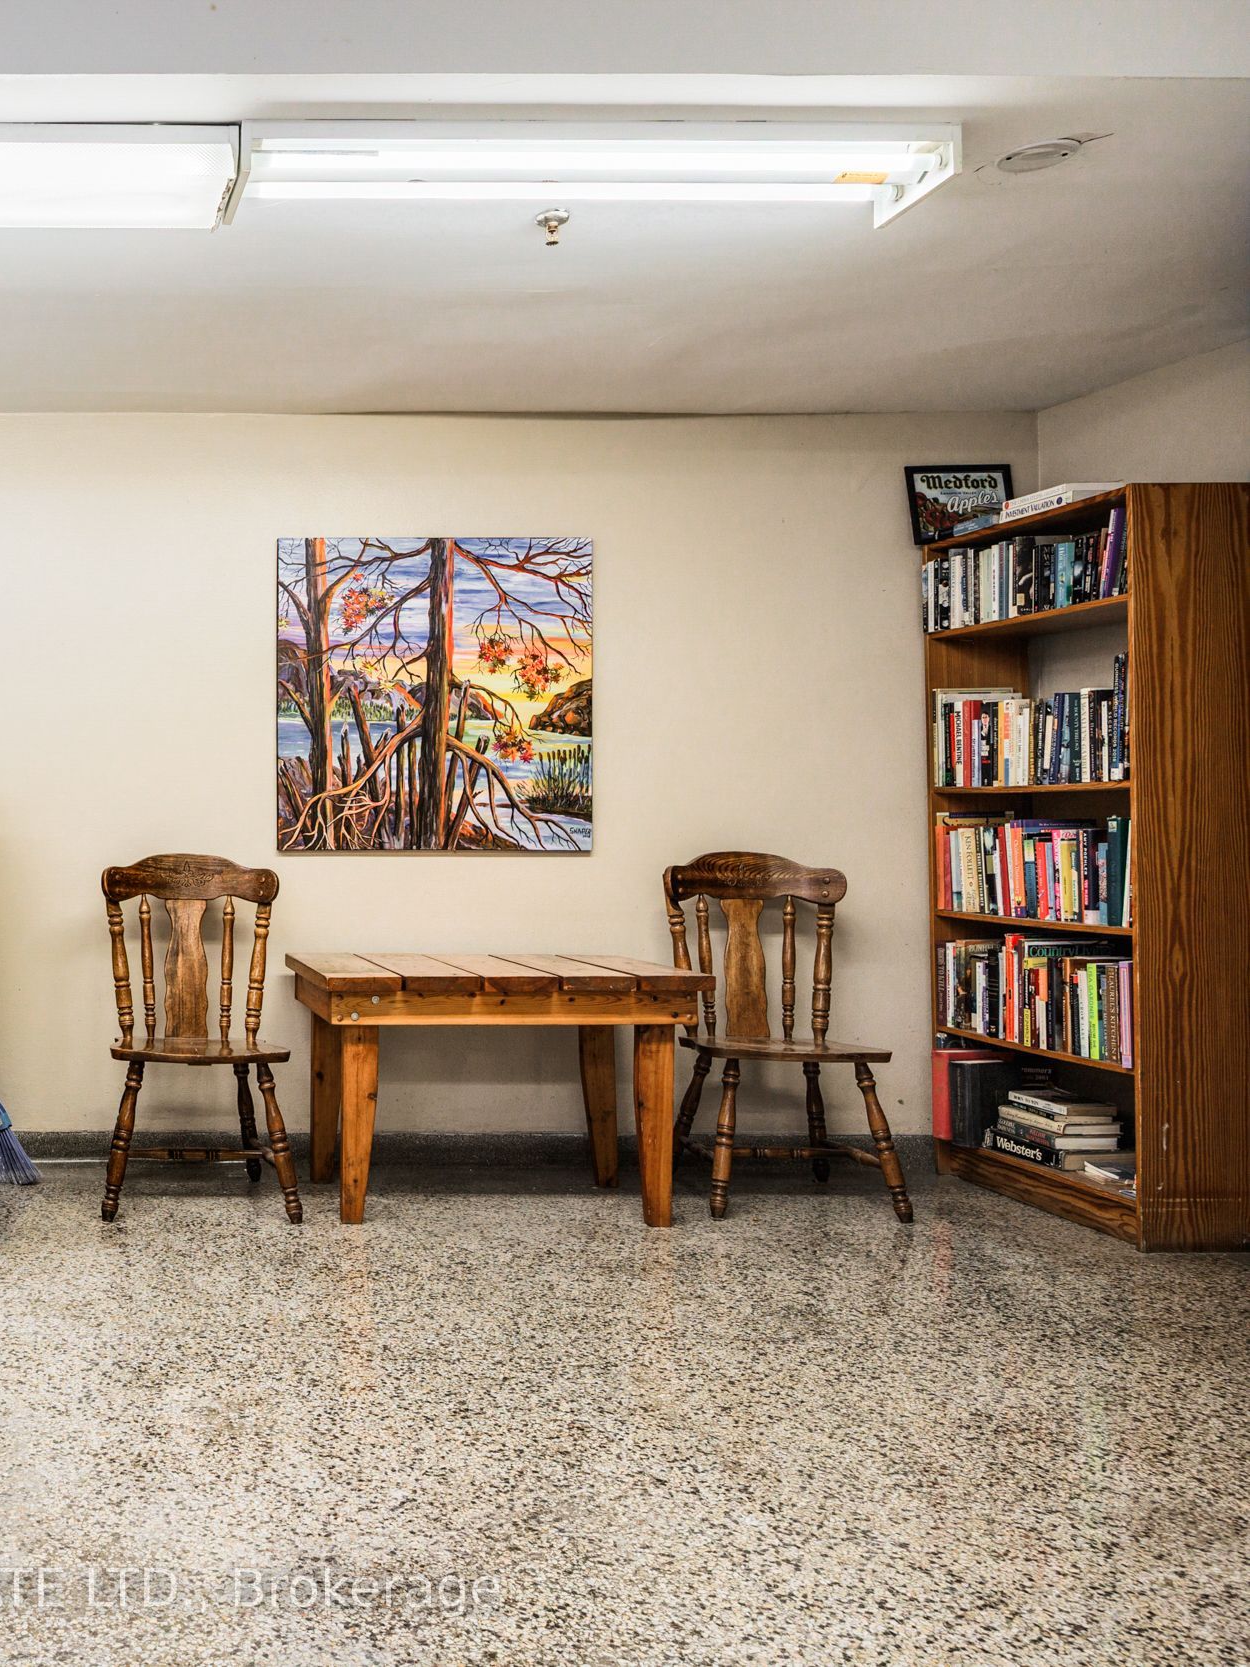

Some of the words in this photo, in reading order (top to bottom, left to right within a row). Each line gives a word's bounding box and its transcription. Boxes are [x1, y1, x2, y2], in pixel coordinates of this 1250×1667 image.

[920, 474, 998, 490] Medford
[1029, 945, 1076, 957] Country
[1108, 975, 1116, 1013] LAUREL'S
[996, 1135, 1043, 1161] Webster's
